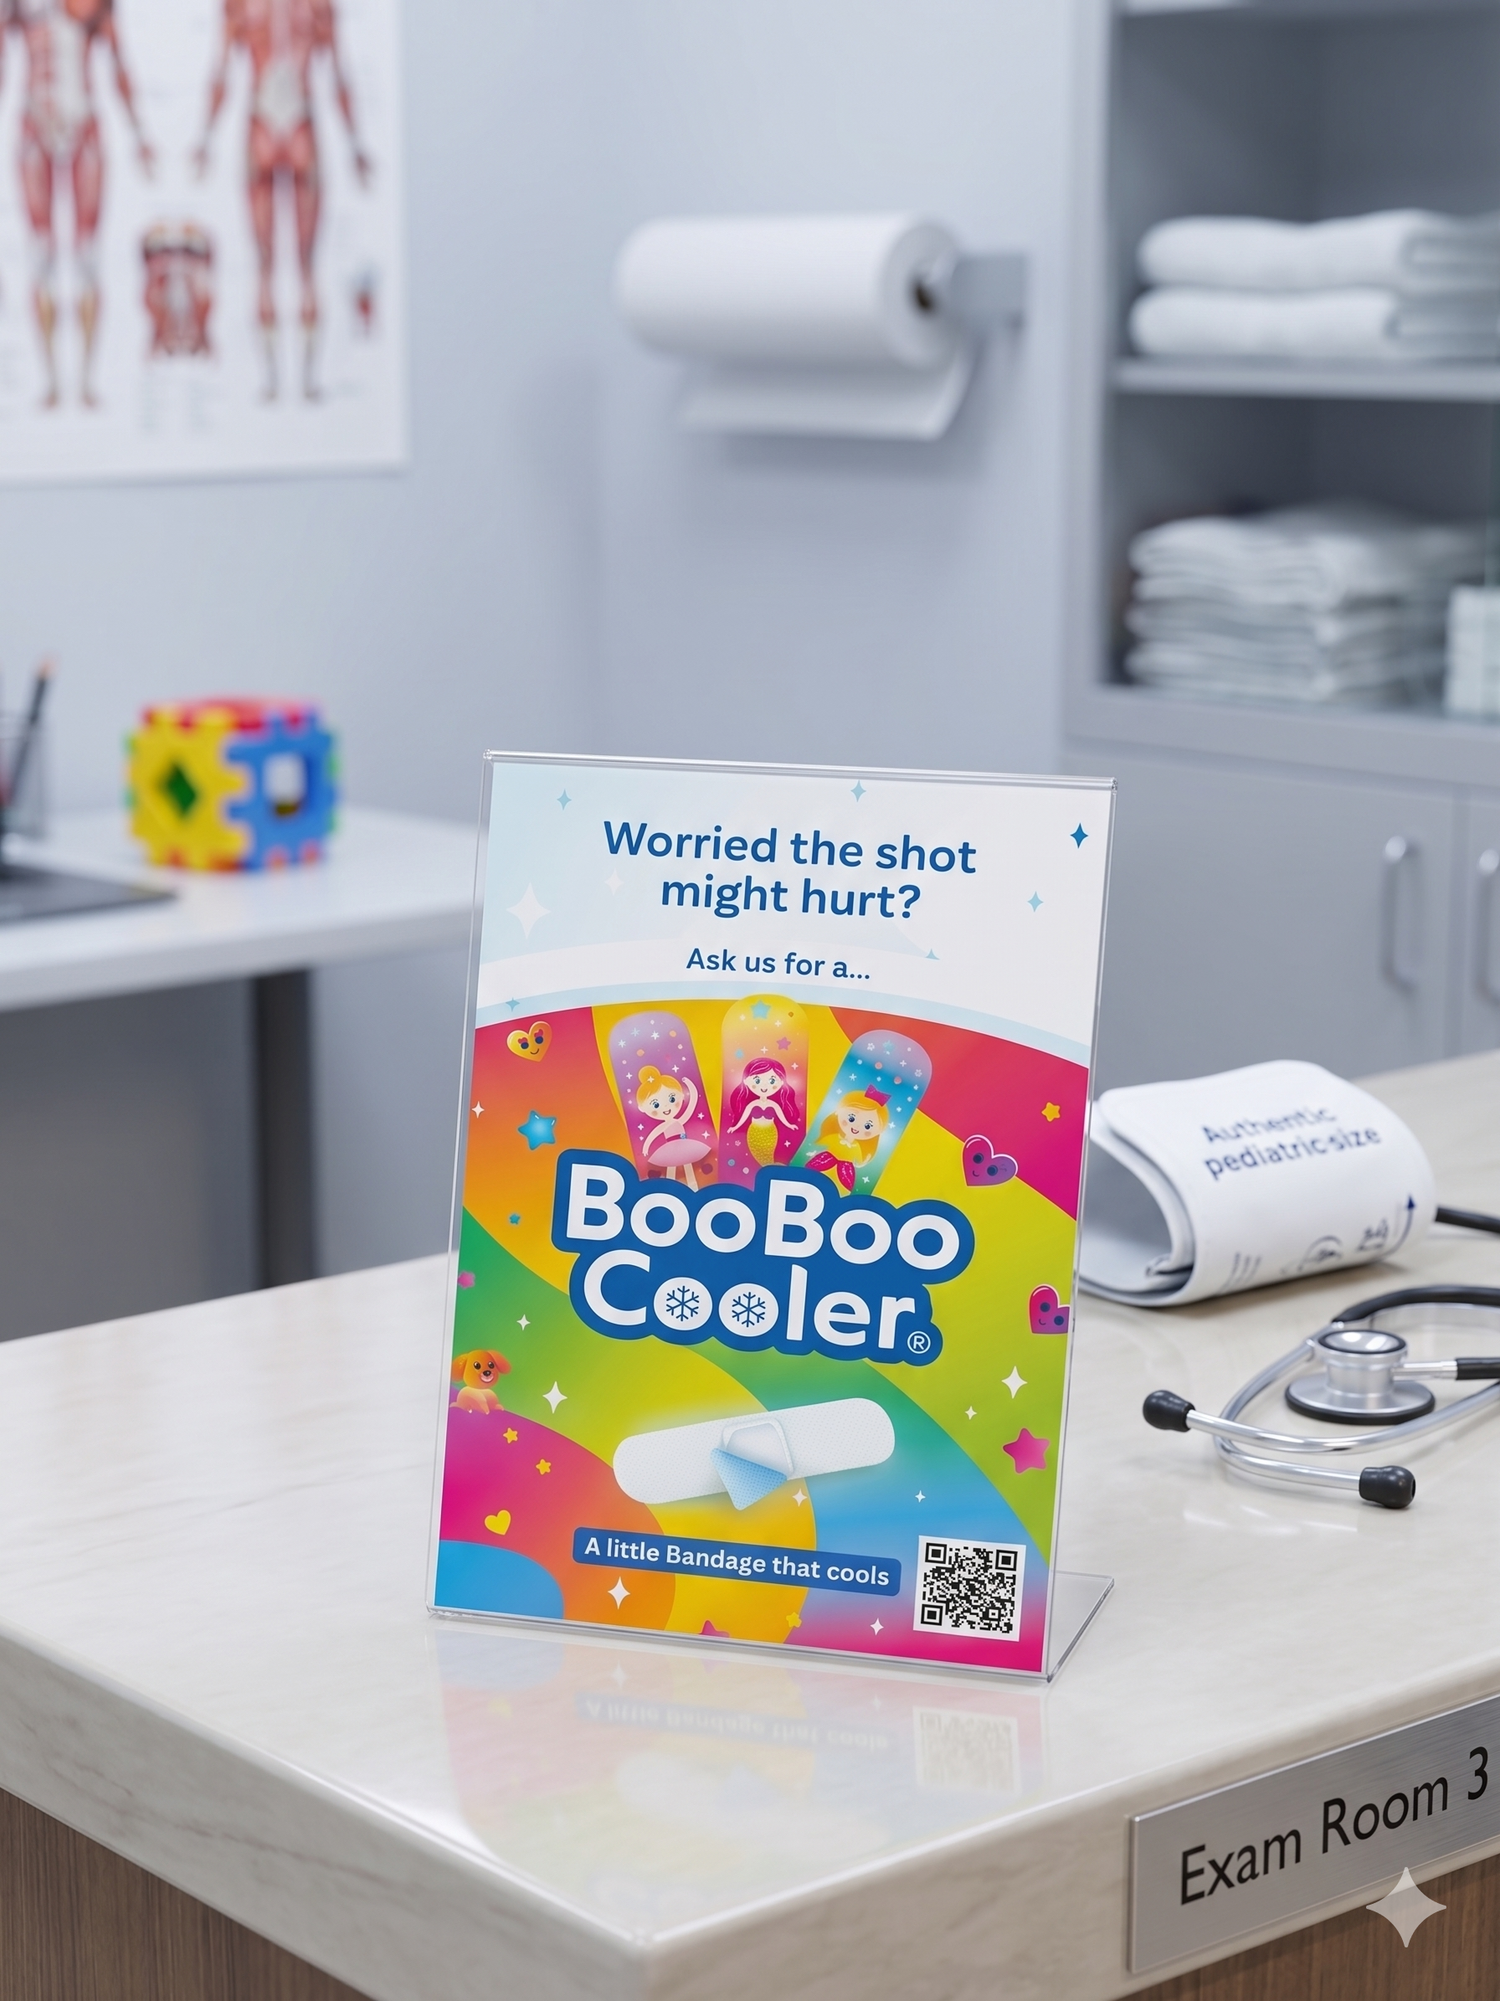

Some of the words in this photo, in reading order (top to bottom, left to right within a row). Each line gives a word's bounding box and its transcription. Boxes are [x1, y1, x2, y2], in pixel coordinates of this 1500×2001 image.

[603, 820, 778, 864] Worried
[789, 829, 863, 868] the
[875, 834, 977, 874] shot
[661, 874, 789, 919] might
[801, 877, 921, 919] hurt?
[686, 947, 737, 973] Ask
[744, 955, 777, 975] us
[784, 951, 826, 977] for
[832, 960, 871, 980] a...
[1202, 1107, 1336, 1144] Authentic
[565, 1162, 961, 1271] BooBoo
[584, 1537, 602, 1557] A
[606, 1537, 660, 1563] little
[666, 1544, 767, 1576] Bandage
[771, 1554, 822, 1580] that
[826, 1563, 890, 1587] cools
[1180, 1828, 1302, 1906] Exam
[1321, 1775, 1449, 1855] Room
[1466, 1745, 1489, 1801] 3
